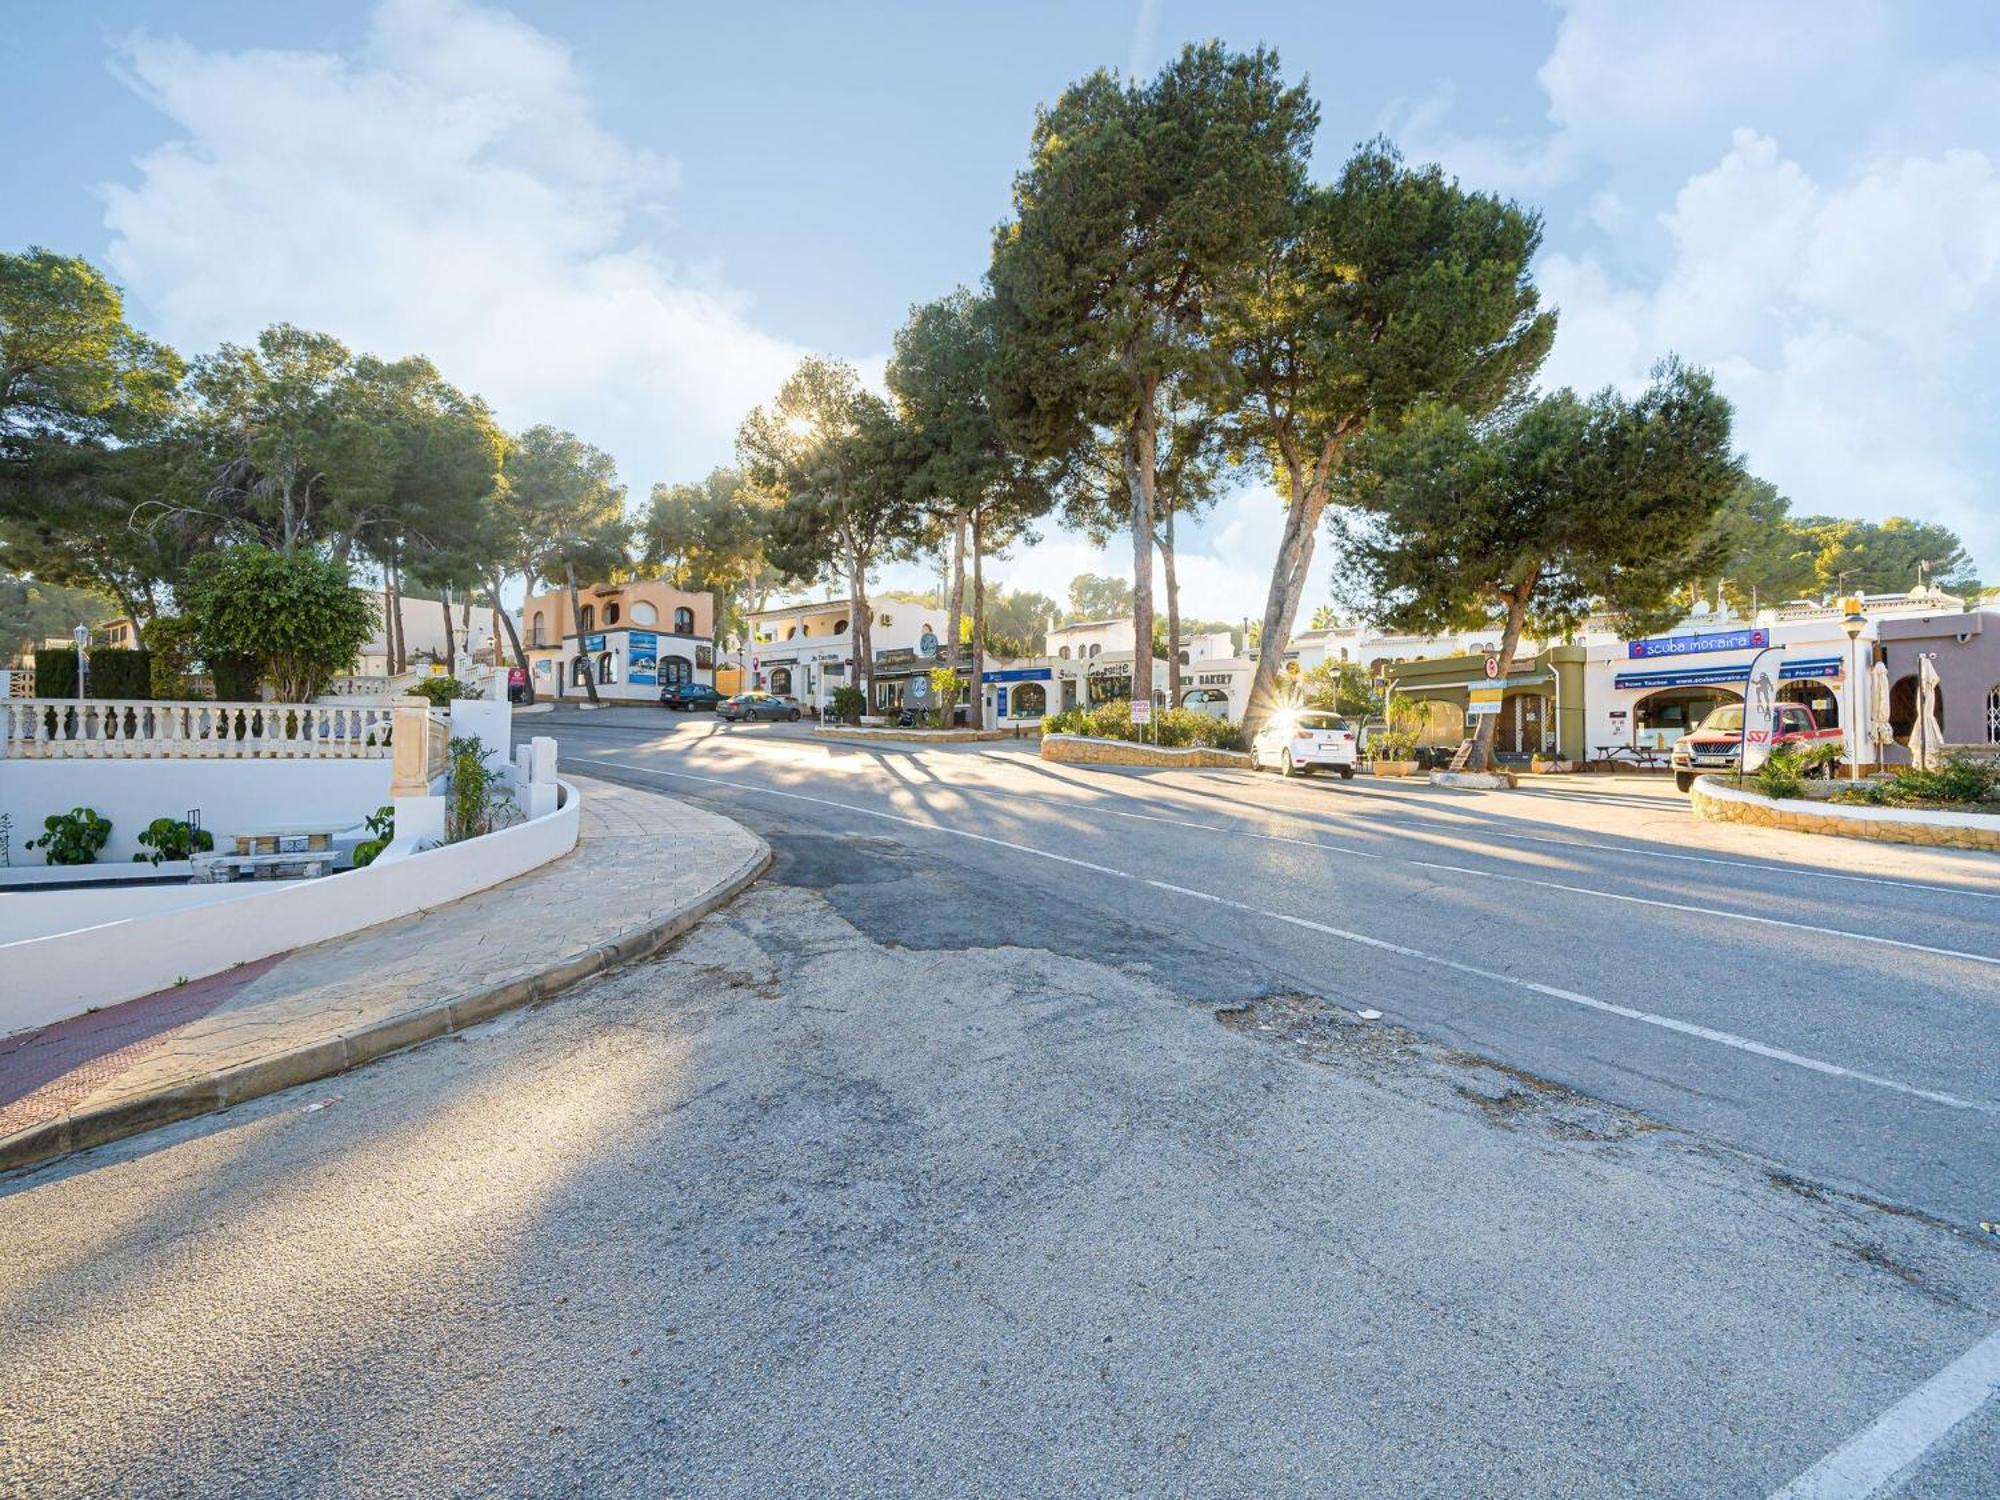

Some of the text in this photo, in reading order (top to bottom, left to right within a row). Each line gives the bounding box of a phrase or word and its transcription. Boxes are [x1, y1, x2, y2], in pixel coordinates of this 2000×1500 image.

[1647, 636, 1747, 655] scuba moraira
[1199, 674, 1232, 685] BAKERY
[1747, 729, 1769, 742] SSI
